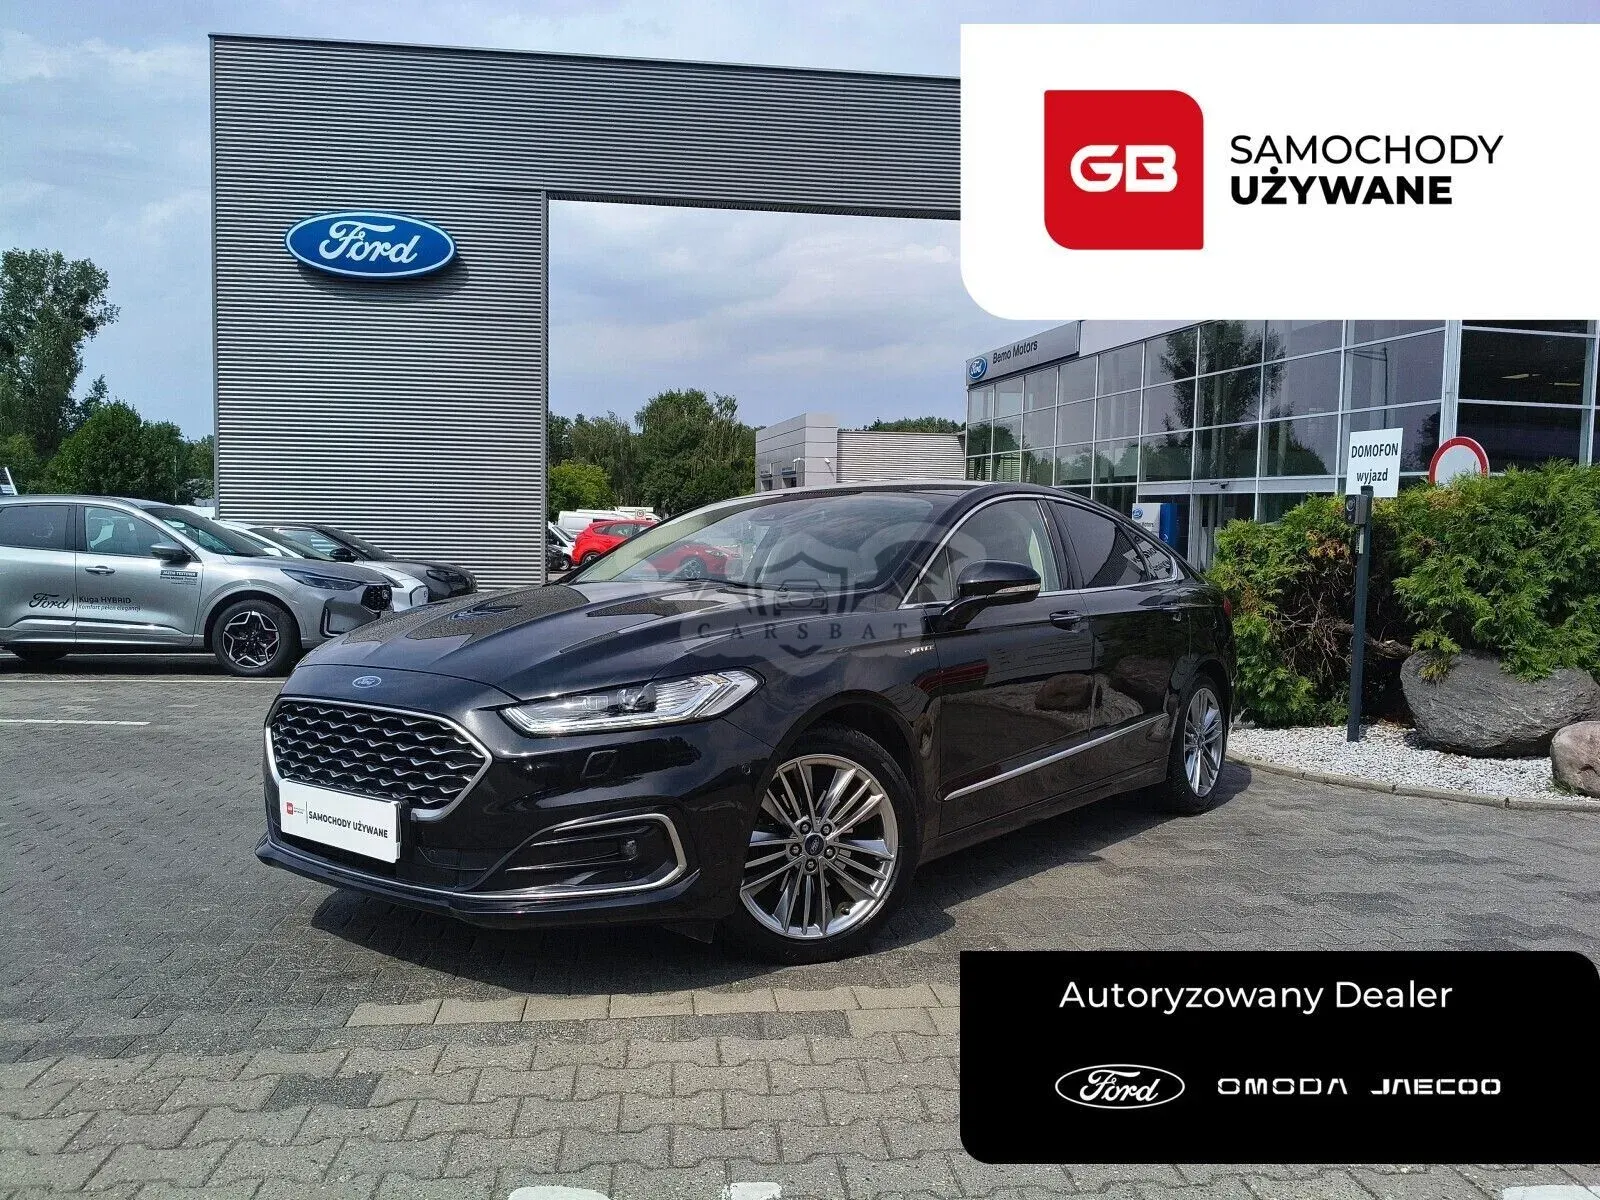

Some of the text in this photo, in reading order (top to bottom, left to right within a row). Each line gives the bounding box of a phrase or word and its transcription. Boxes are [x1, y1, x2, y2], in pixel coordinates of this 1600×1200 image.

[318, 220, 421, 264] Ford
[993, 340, 1038, 364] Bemo Motors
[1351, 442, 1399, 459] DOMOFON
[1356, 468, 1389, 485] wyjazd
[29, 593, 70, 609] Ford
[79, 595, 132, 604] Kuga HYBRID
[308, 811, 388, 839] SAMOCHODY UŻYWANE
